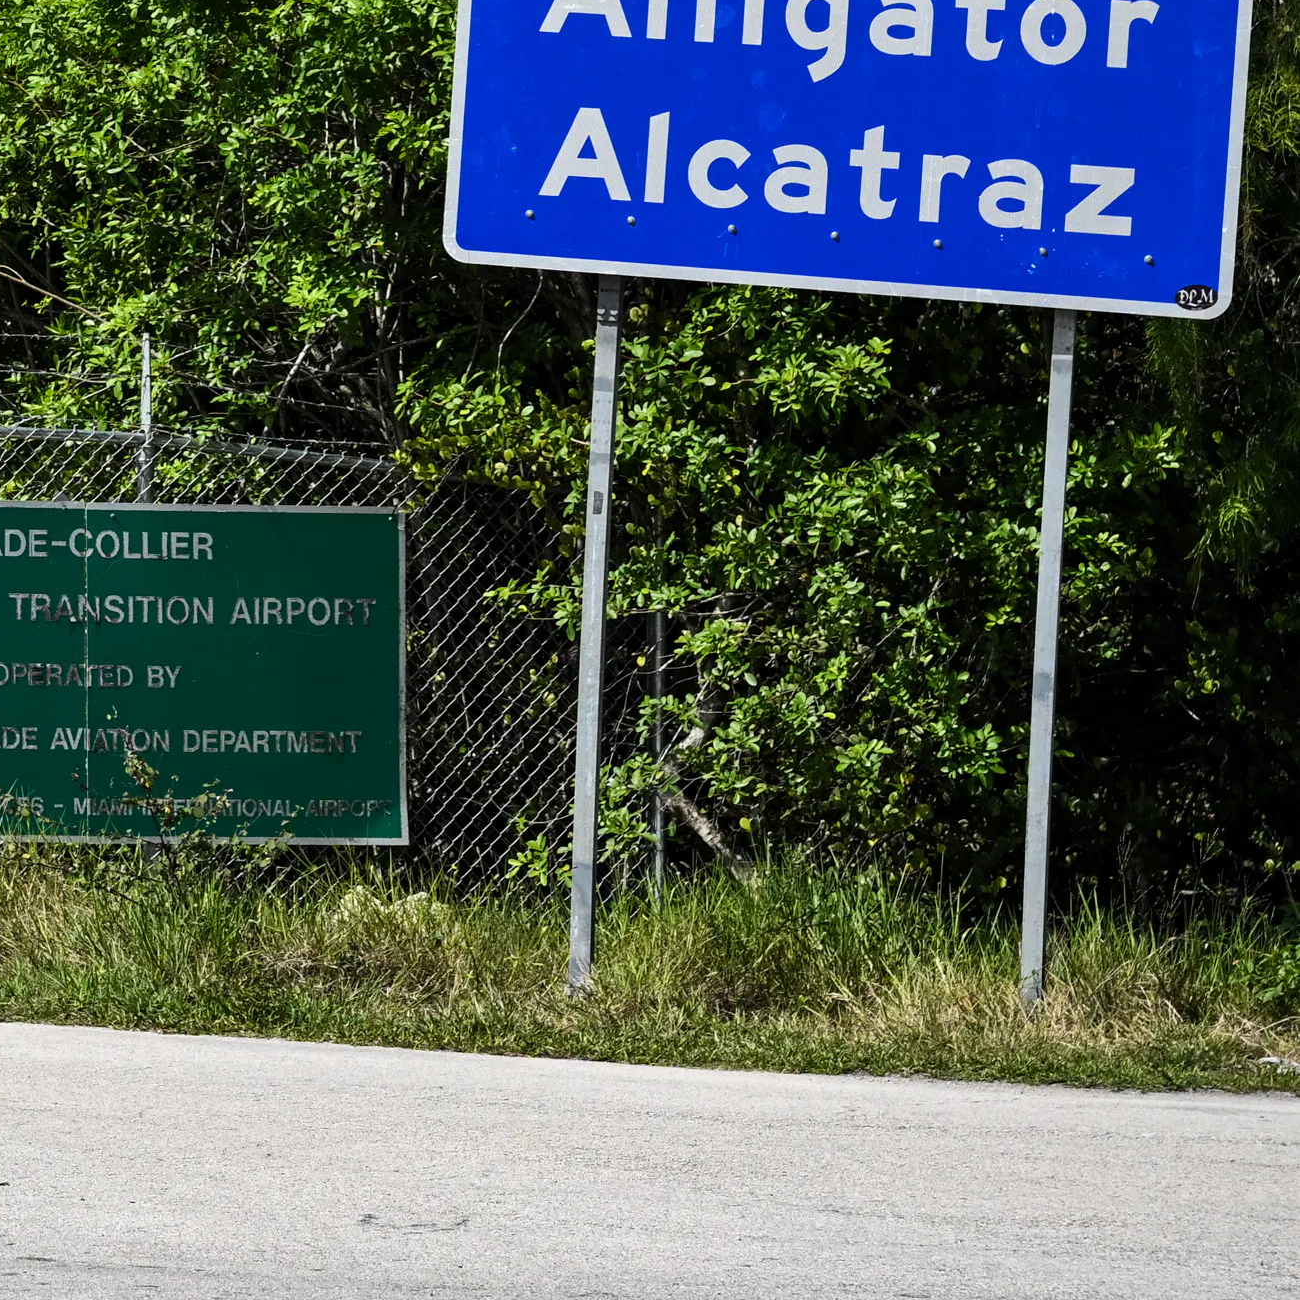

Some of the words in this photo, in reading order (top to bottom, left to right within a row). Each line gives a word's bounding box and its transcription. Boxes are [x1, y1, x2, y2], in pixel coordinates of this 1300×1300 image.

[538, 106, 1136, 236] Alcatraz
[9, 592, 214, 624] TRANSITION
[230, 596, 376, 626] AIRPORT
[147, 665, 182, 688] BY
[50, 727, 170, 752] AVIATION
[183, 729, 362, 753] DEPARTMENT
[73, 797, 133, 816] MIAMI
